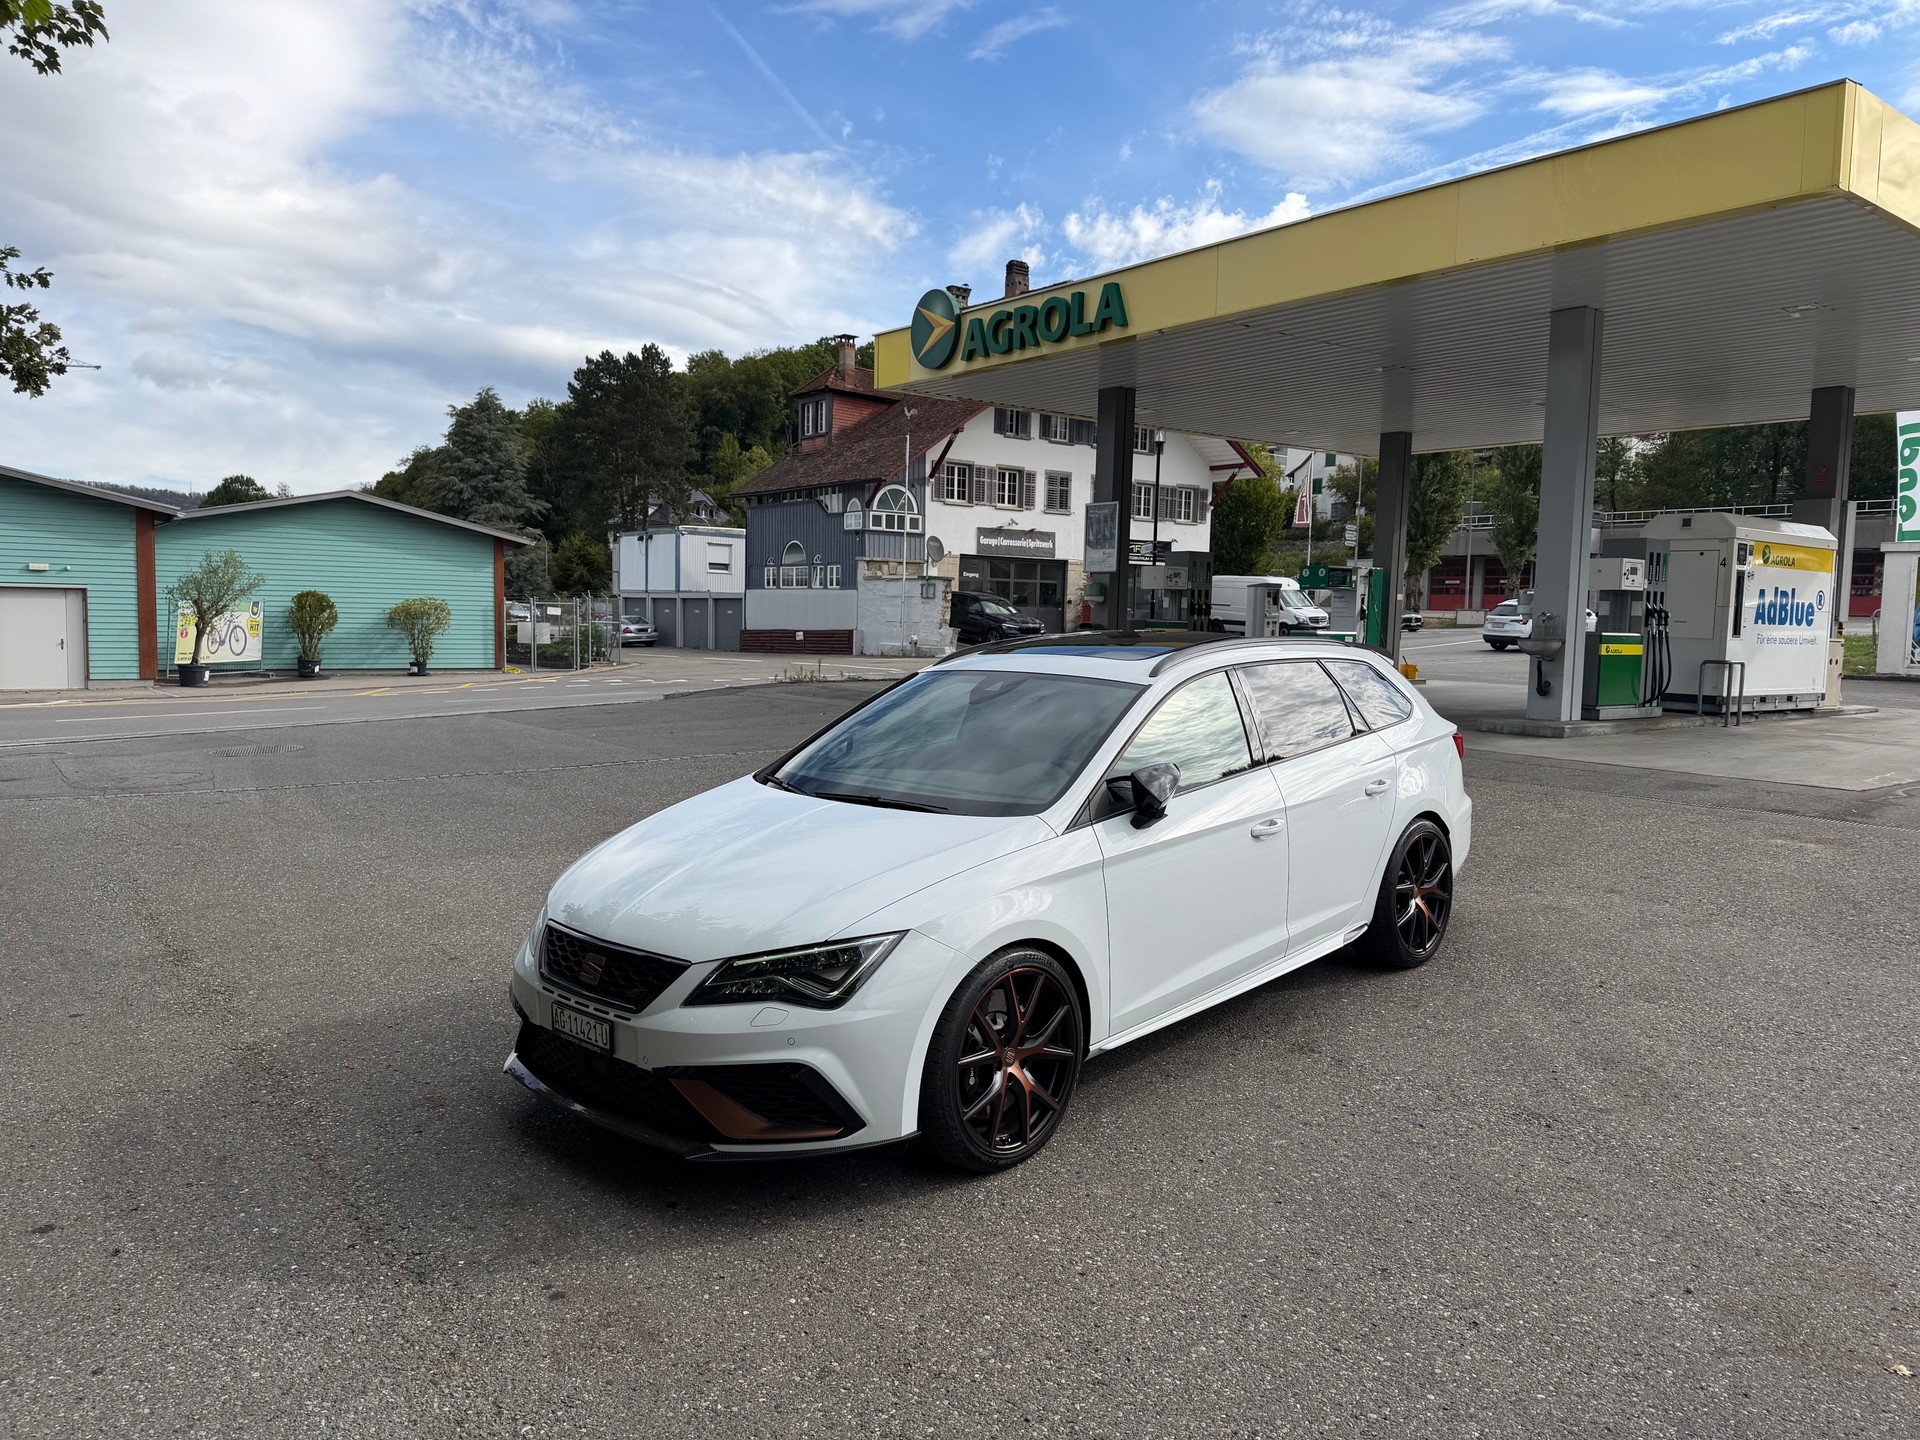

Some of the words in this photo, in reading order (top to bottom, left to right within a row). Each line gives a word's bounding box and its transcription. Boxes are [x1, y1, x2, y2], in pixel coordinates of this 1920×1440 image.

[961, 282, 1128, 361] AGROLA
[980, 535, 997, 547] Garage
[1028, 539, 1053, 549] Spritzwerk
[1720, 557, 1727, 568] 4
[1770, 555, 1796, 567] AGROLA
[1756, 633, 1765, 645] Für
[1766, 635, 1777, 645] eine
[1778, 634, 1798, 645] saubere
